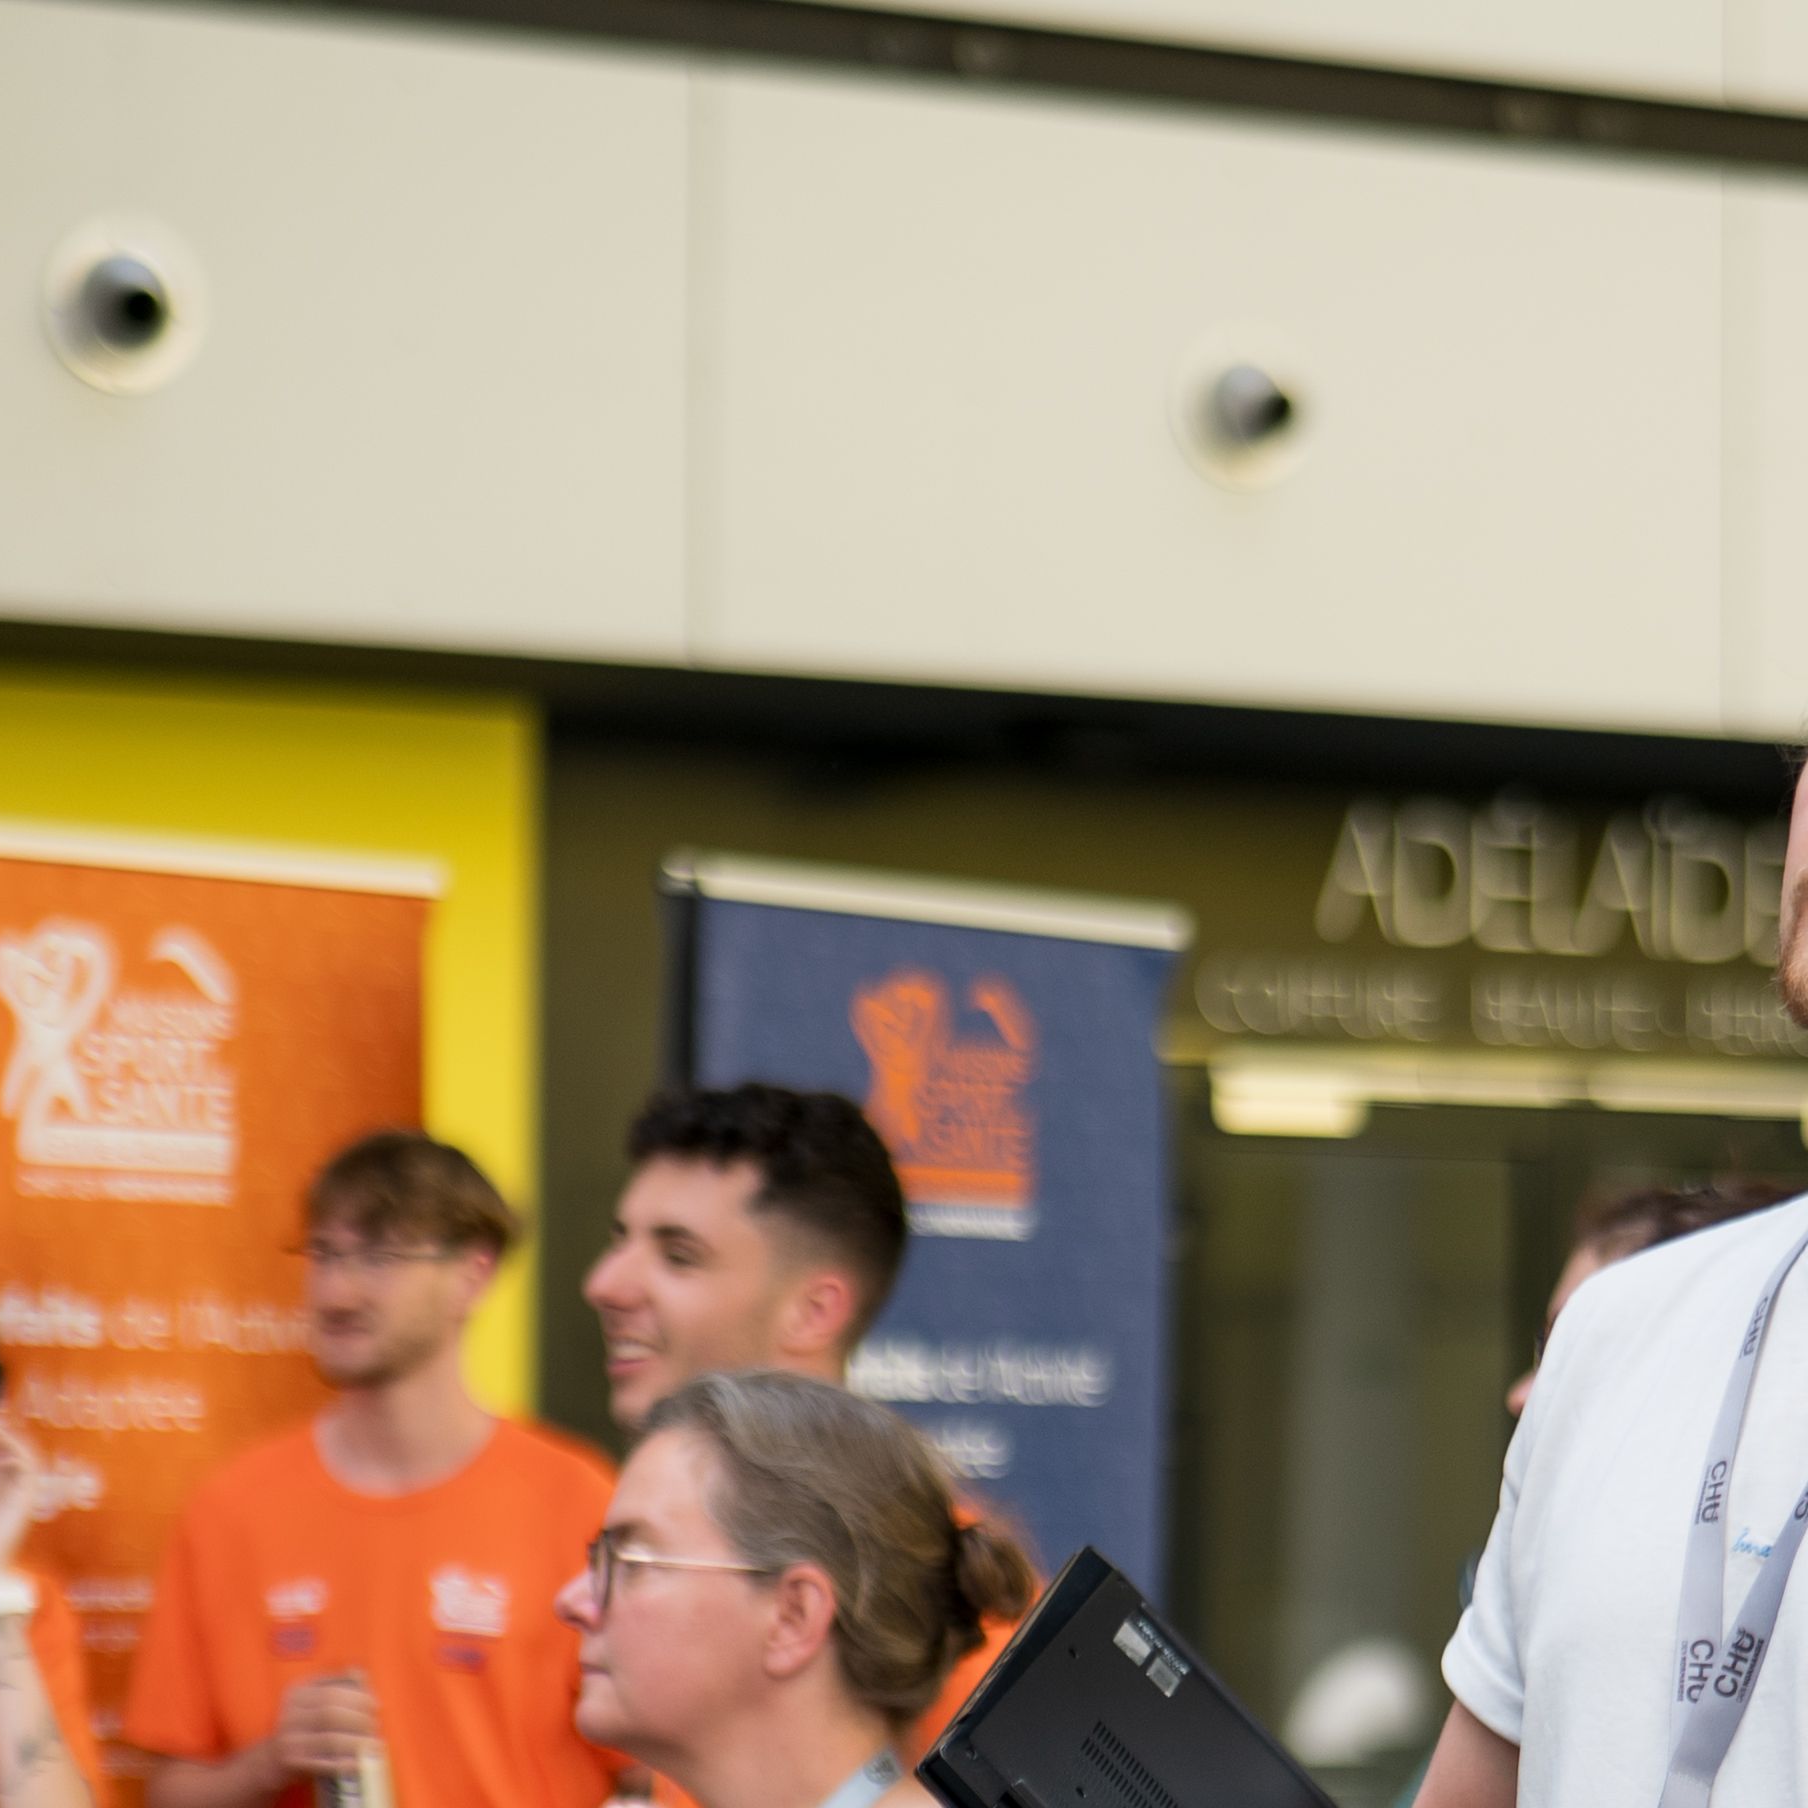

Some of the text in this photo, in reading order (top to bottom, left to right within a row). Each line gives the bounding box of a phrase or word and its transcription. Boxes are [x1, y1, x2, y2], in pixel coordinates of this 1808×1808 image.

[1702, 1461, 1726, 1522] CHU
[1686, 1639, 1714, 1704] CHU
[1714, 1630, 1760, 1697] CHU
